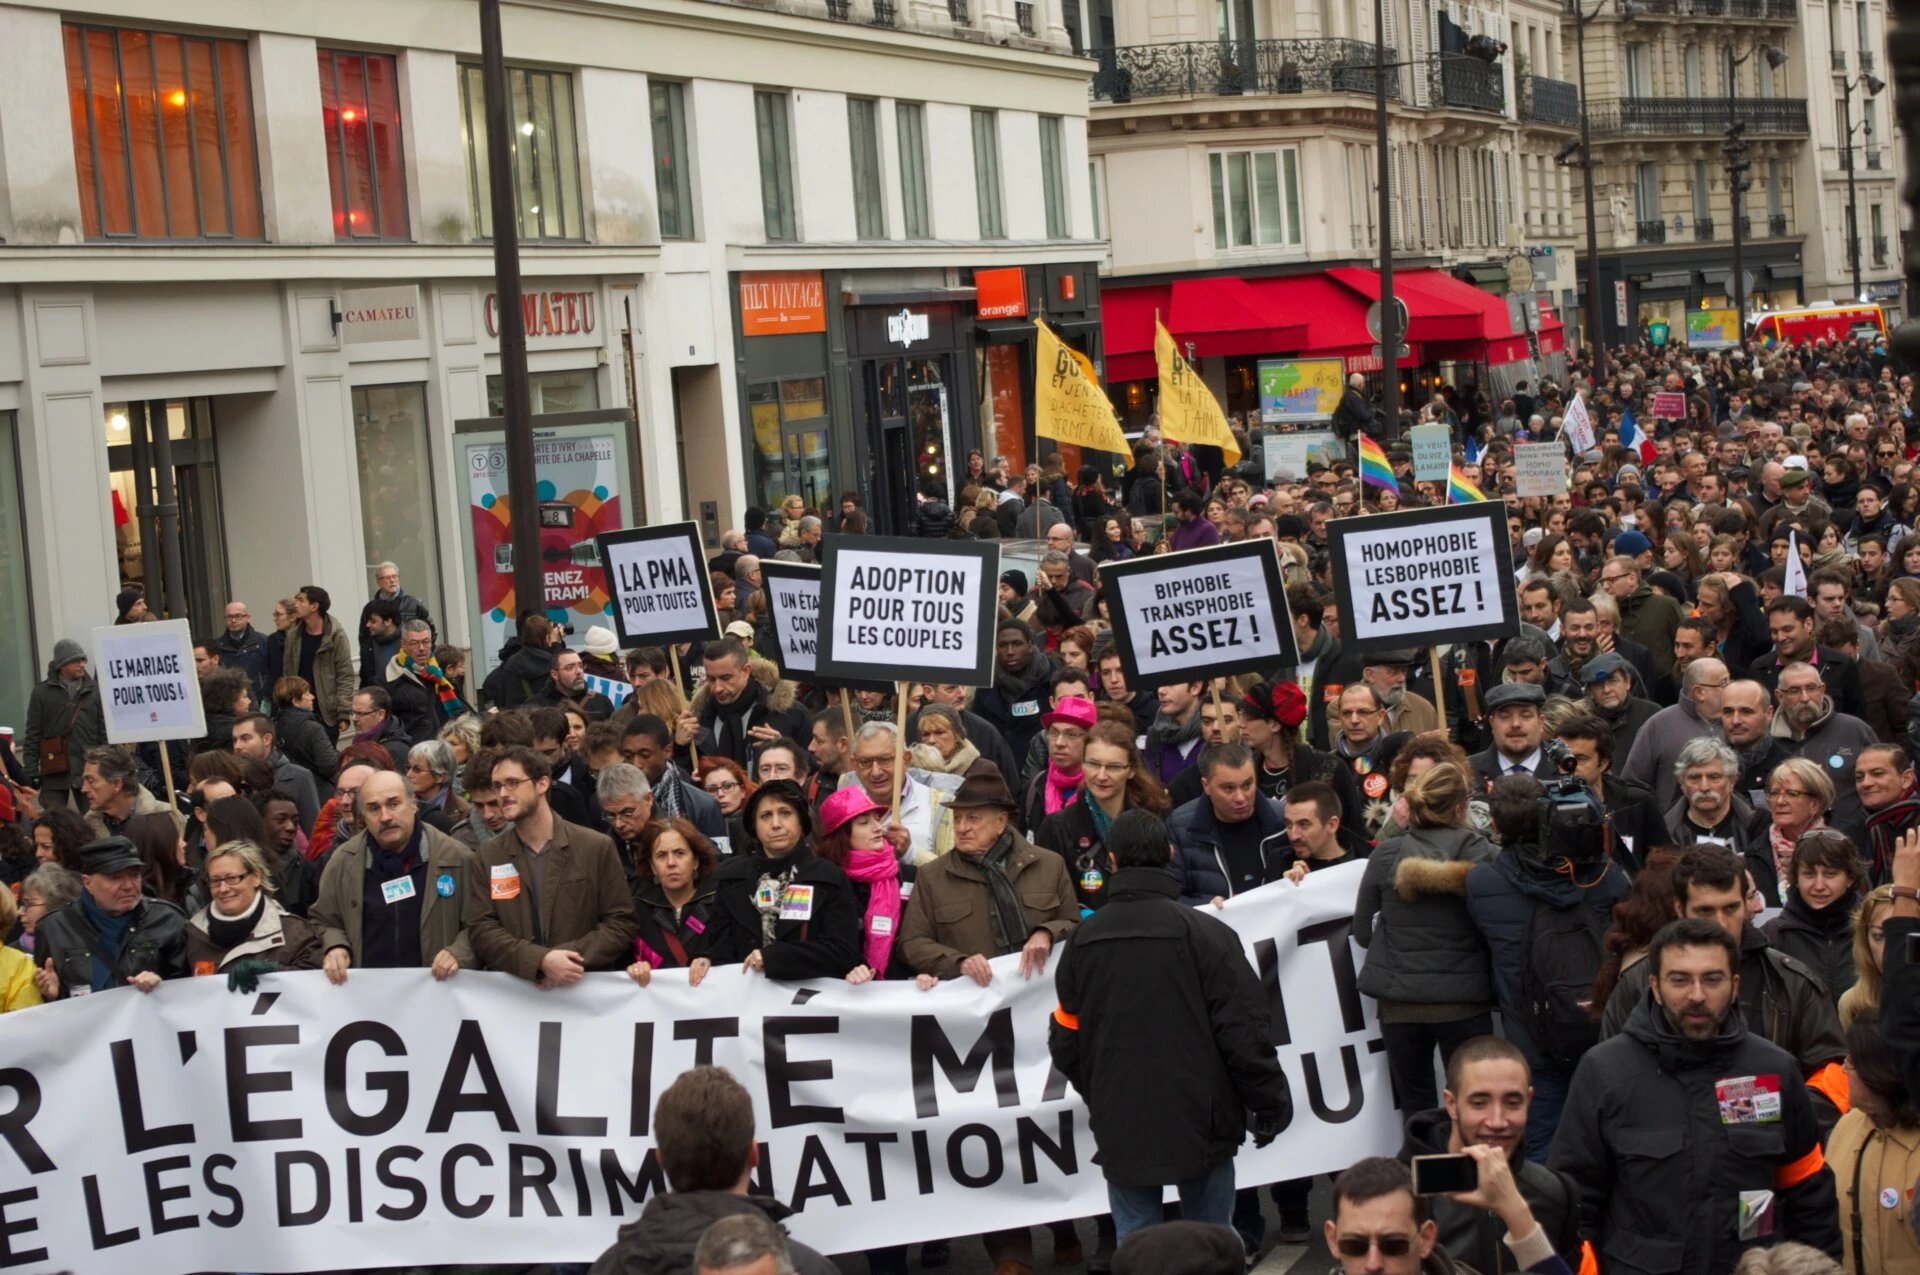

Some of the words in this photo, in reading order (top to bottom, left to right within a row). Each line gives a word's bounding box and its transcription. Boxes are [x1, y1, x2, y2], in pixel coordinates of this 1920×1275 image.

[741, 284, 768, 310] TILT
[772, 282, 821, 309] VINTAGE
[552, 442, 576, 453] D'IVRY
[552, 455, 561, 464] DE
[563, 454, 574, 463] LA
[576, 450, 611, 462] CHAPELLE
[1361, 531, 1479, 563] HOMOPHOBIE
[619, 564, 645, 593] LA
[648, 556, 693, 589] PMA
[850, 566, 966, 596] ADOPTION
[1365, 556, 1481, 587] LESBOPHOBIE
[780, 592, 797, 609] UN
[798, 589, 821, 611] ÉTA
[1154, 573, 1232, 600] BIPHOBIE
[624, 595, 656, 615] POUR
[656, 591, 699, 612] TOUTES
[848, 597, 905, 622] POUR
[910, 601, 965, 625] TOUS
[1140, 592, 1256, 624] TRANSPHOBIE
[1370, 583, 1466, 624] ASSEZ
[1474, 580, 1485, 611] !
[789, 633, 800, 654] À
[847, 625, 879, 646] LES
[882, 627, 963, 651] COUPLES
[1150, 617, 1243, 658] ASSEZ
[1249, 614, 1261, 643] !
[109, 659, 124, 680] LE
[125, 654, 181, 678] MARIAGE
[112, 685, 145, 706] POUR
[145, 682, 178, 703] TOUS
[110, 988, 845, 1155] L'ÉGALITÉ
[82, 1154, 244, 1251] LES
